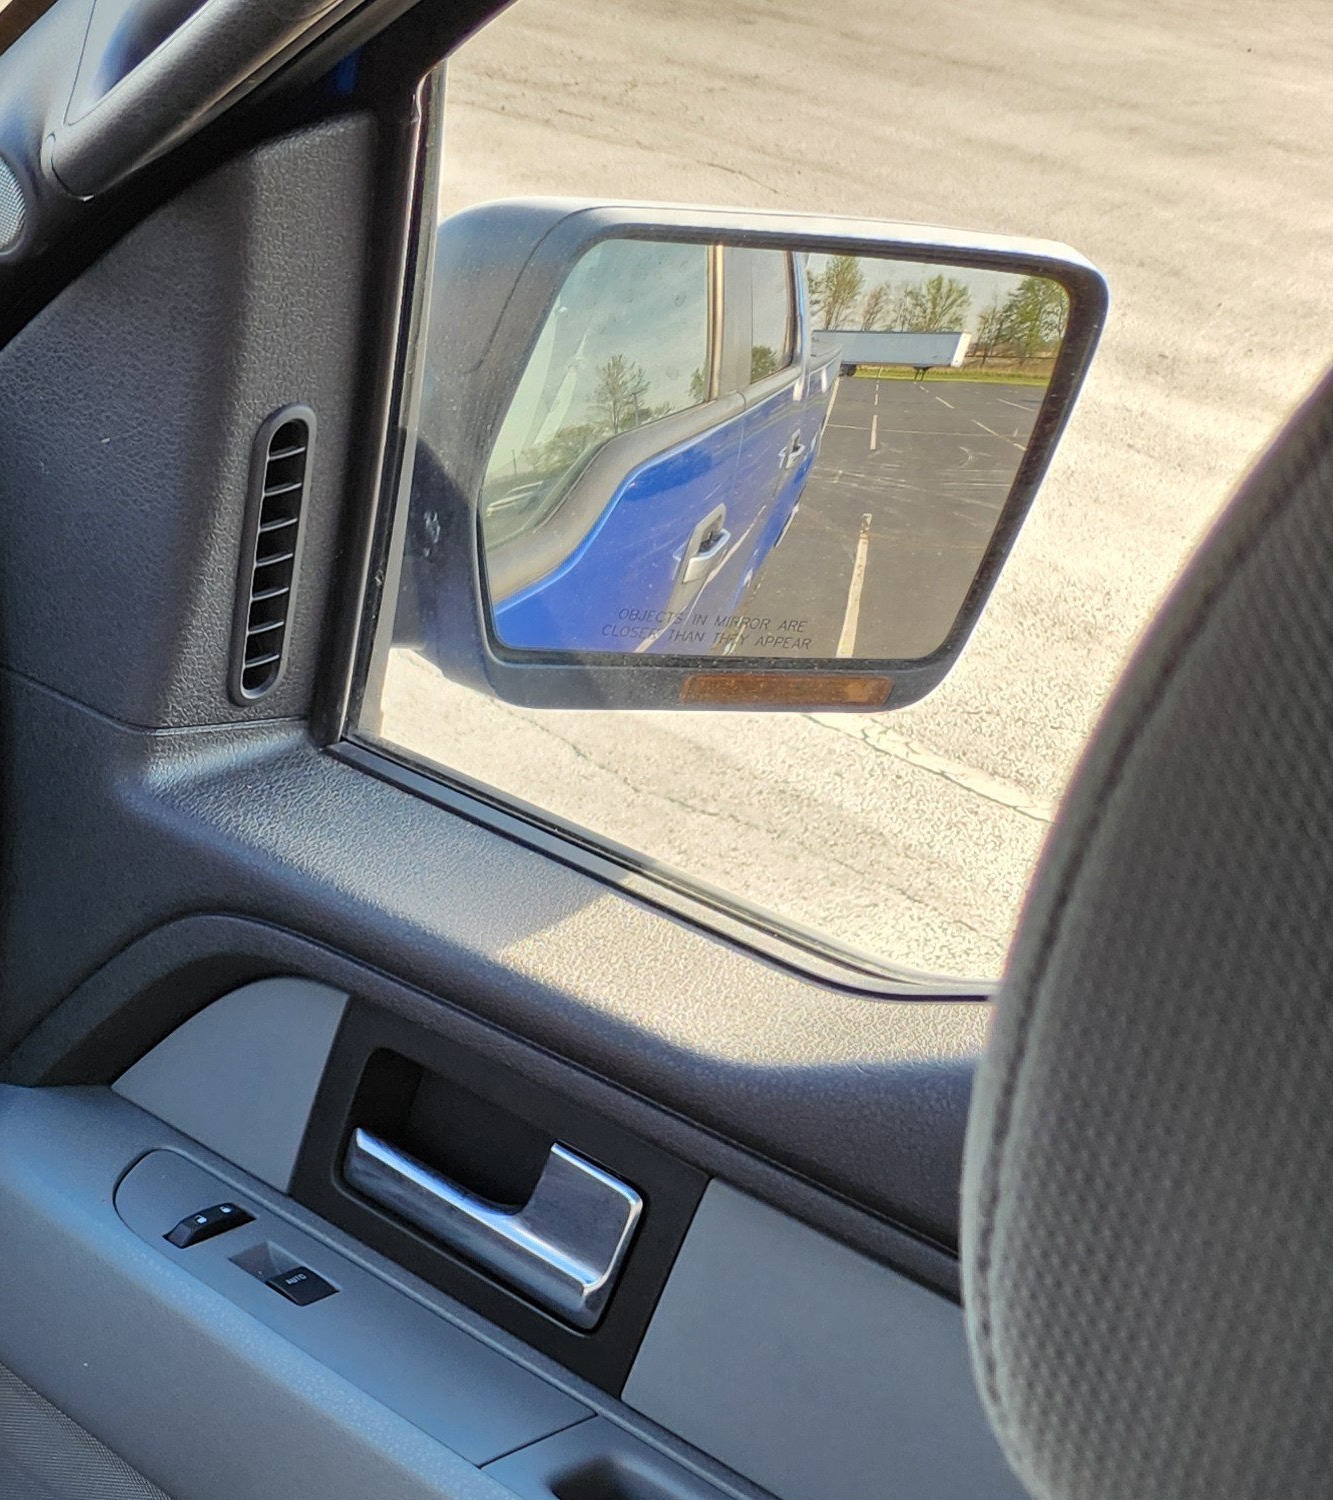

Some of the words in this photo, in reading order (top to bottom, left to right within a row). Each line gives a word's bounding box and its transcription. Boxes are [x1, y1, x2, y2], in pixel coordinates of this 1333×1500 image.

[618, 607, 683, 624] OBJECTS
[691, 613, 707, 626] IN
[713, 615, 772, 631] MIRROR
[778, 618, 808, 633] ARE
[668, 628, 706, 643] THAN
[754, 634, 812, 650] APPEAR
[284, 1271, 307, 1286] AUTO
